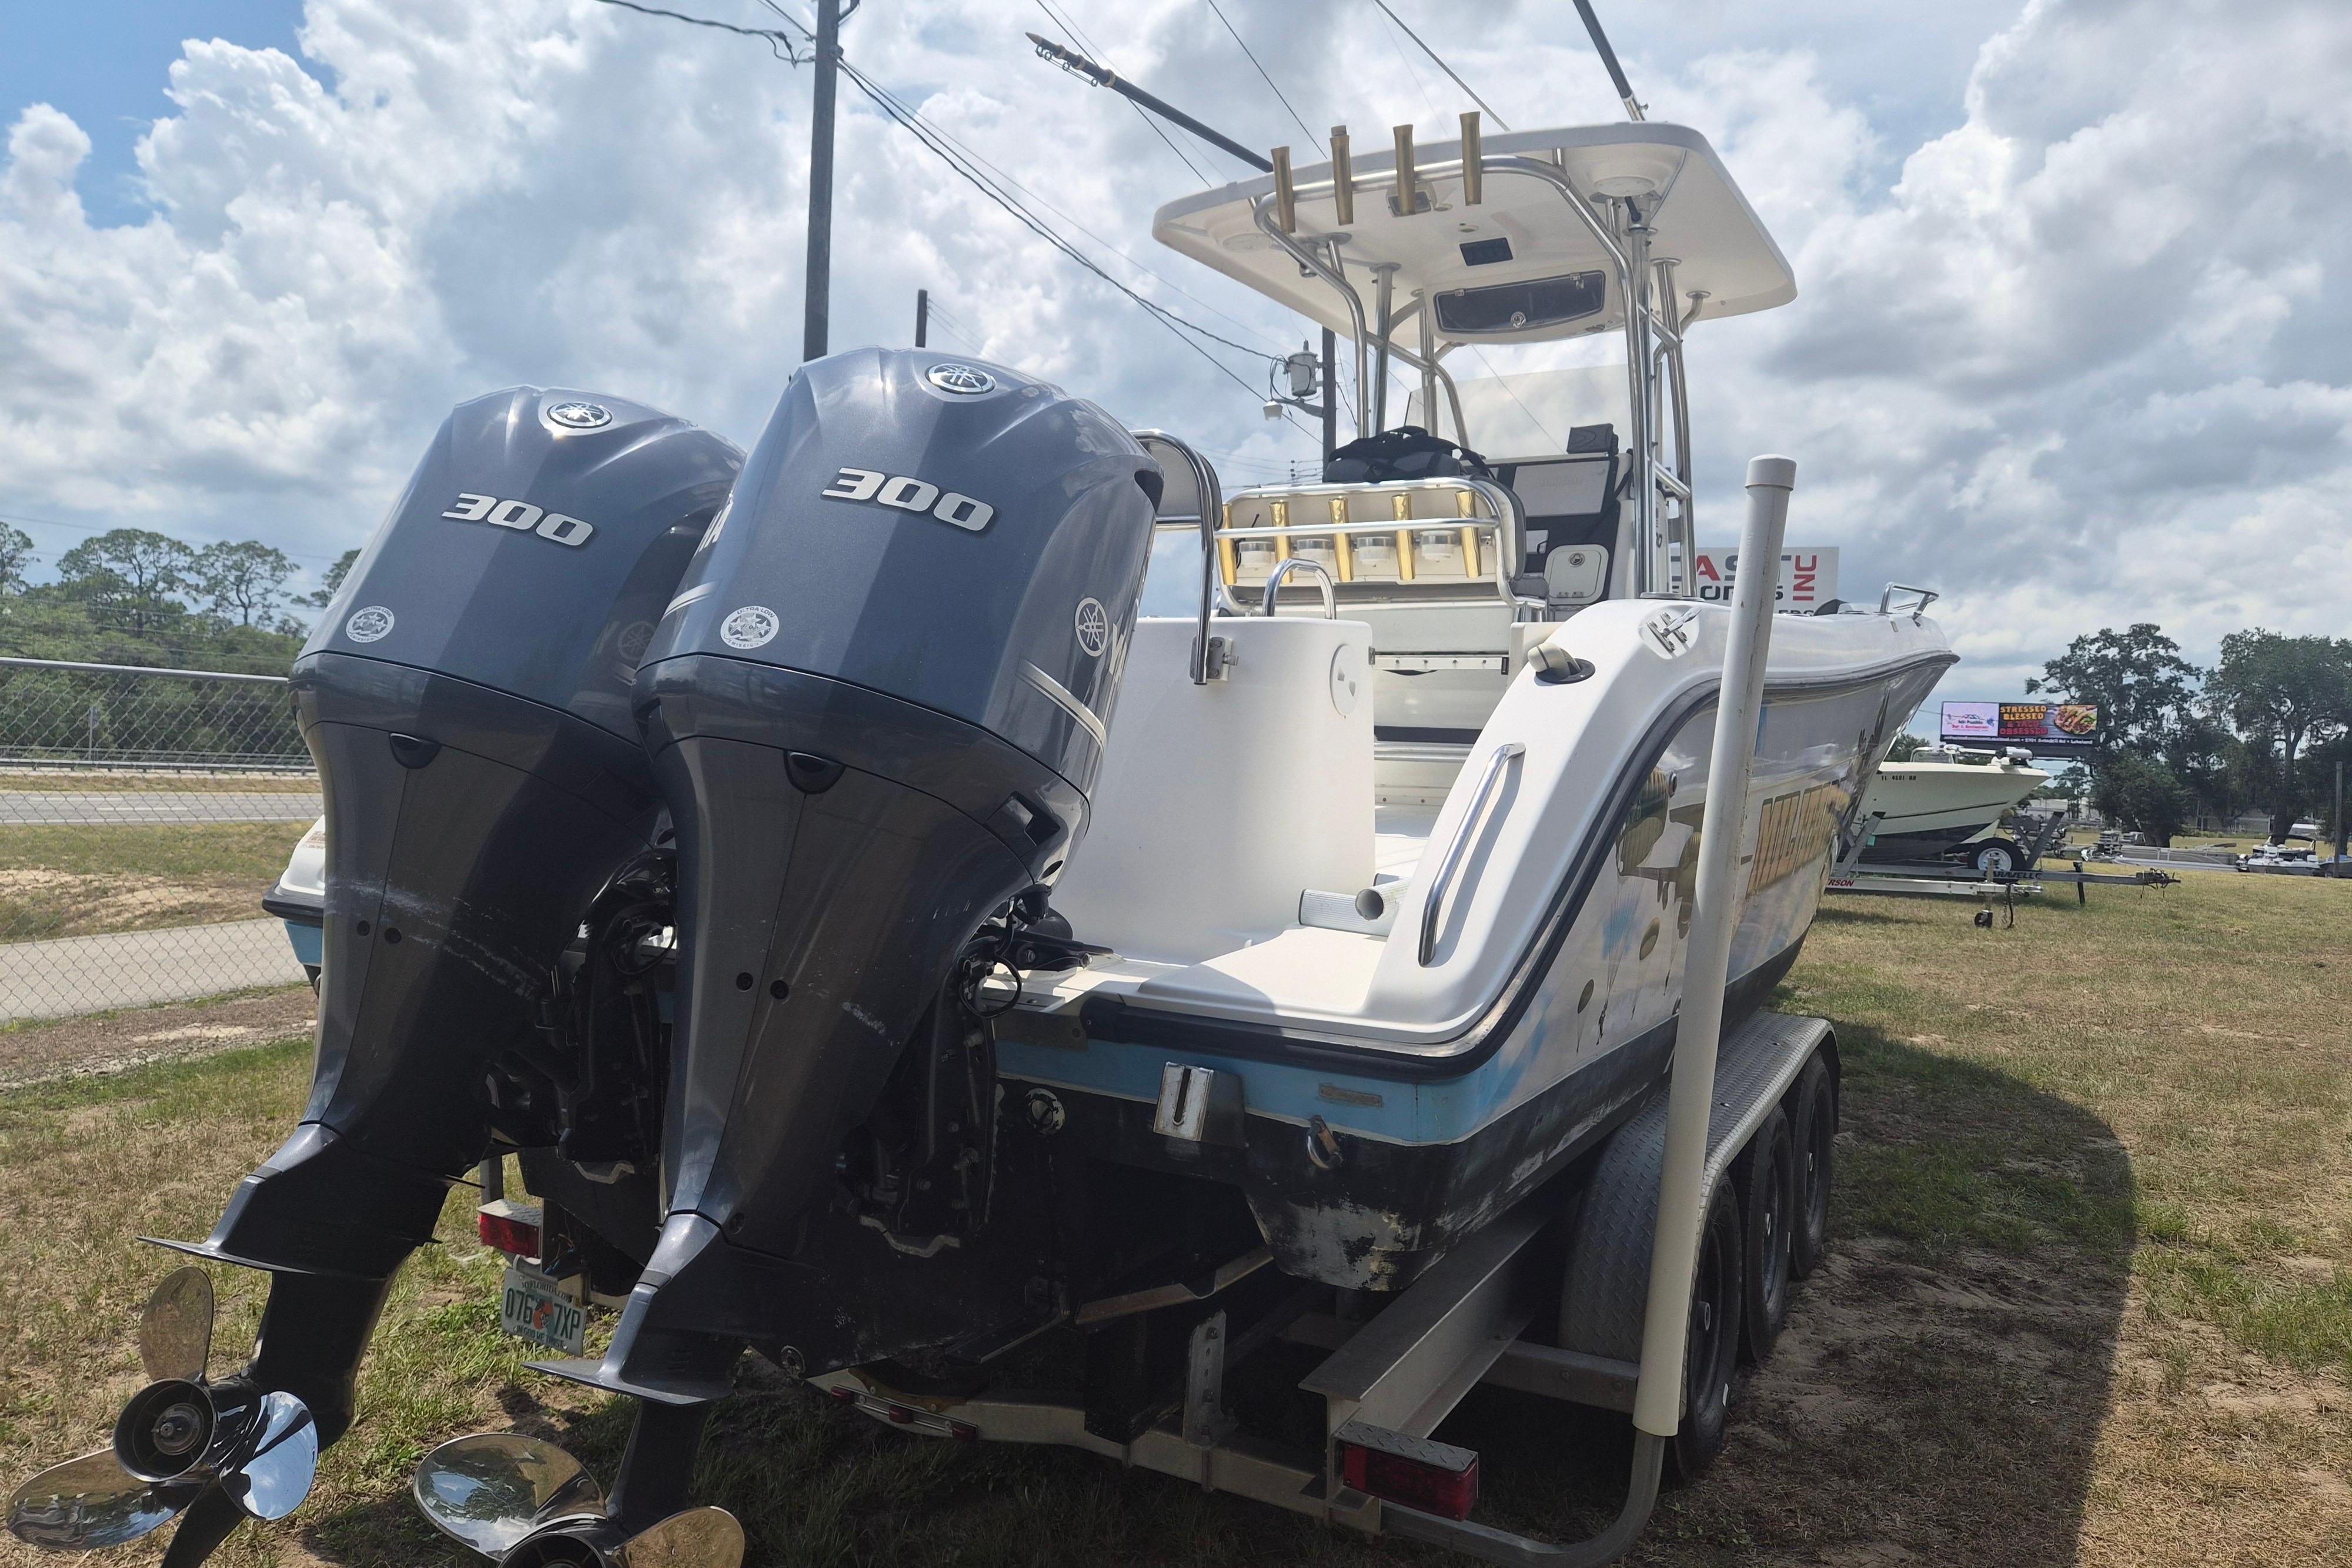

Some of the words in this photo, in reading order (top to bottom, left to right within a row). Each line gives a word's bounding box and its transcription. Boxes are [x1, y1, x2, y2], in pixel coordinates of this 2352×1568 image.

[441, 493, 593, 546] 300
[821, 467, 994, 531] 300
[1792, 554, 1817, 601] INC
[761, 608, 776, 618] LOW
[505, 1286, 533, 1323] 076
[554, 1302, 581, 1340] 7XP
